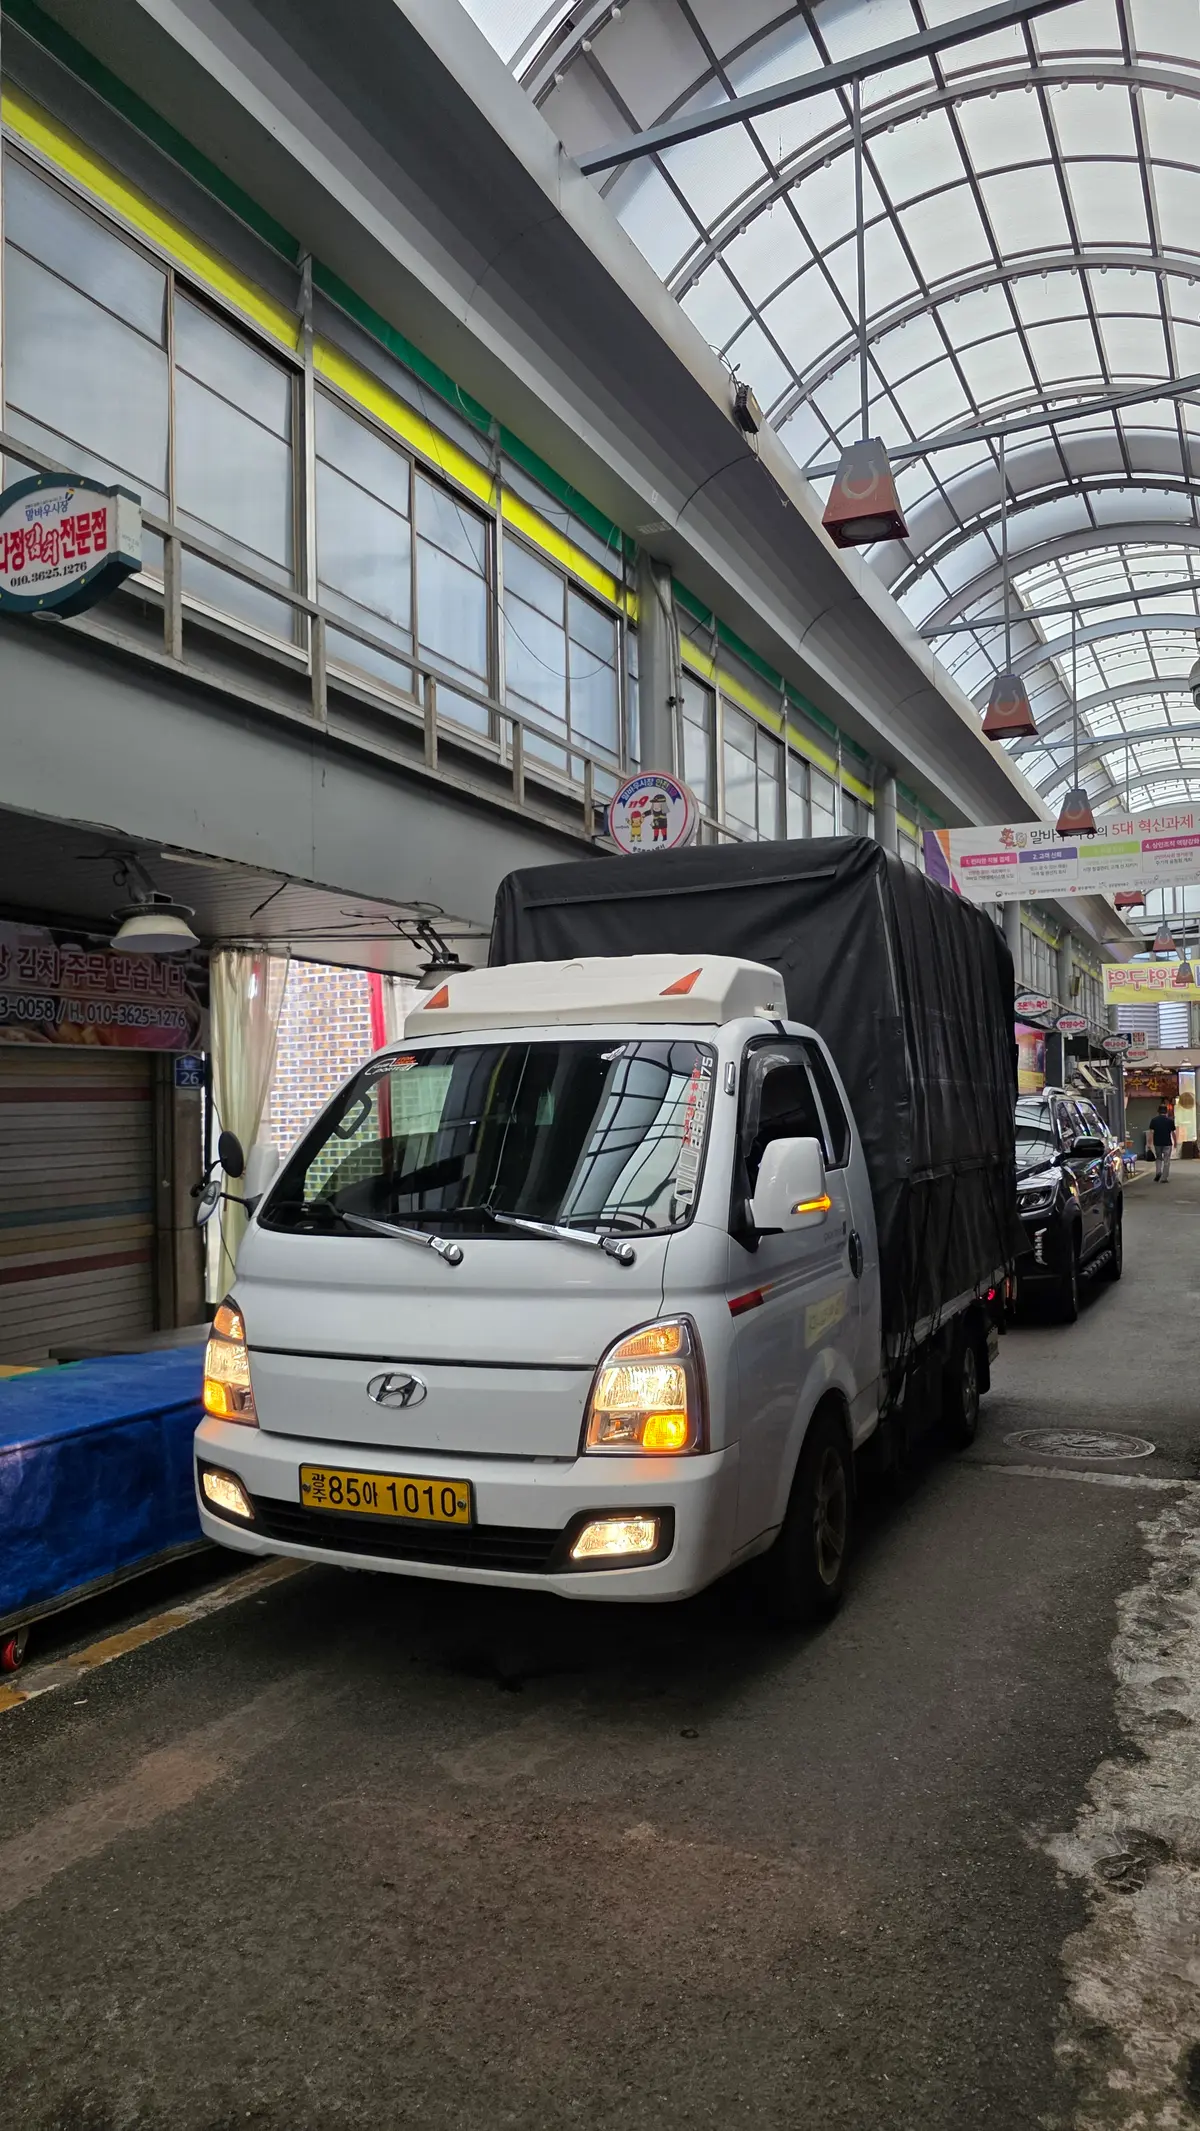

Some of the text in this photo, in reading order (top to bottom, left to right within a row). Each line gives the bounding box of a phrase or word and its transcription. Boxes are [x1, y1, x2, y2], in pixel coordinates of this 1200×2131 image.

[25, 499, 69, 522] 말바우시장
[10, 561, 88, 588] 010.3625.1276
[628, 795, 650, 809] 119
[1030, 813, 1194, 843] 말바의 5대 혁신과제
[17, 946, 60, 984] 김치
[64, 952, 109, 988] 주문
[112, 957, 187, 996] 받습니다
[87, 1004, 187, 1029] 010-3625-1276
[180, 1071, 200, 1085] 26
[675, 1148, 699, 1205] 010
[311, 1472, 327, 1503] 광주
[329, 1475, 458, 1518] 85아 1010
